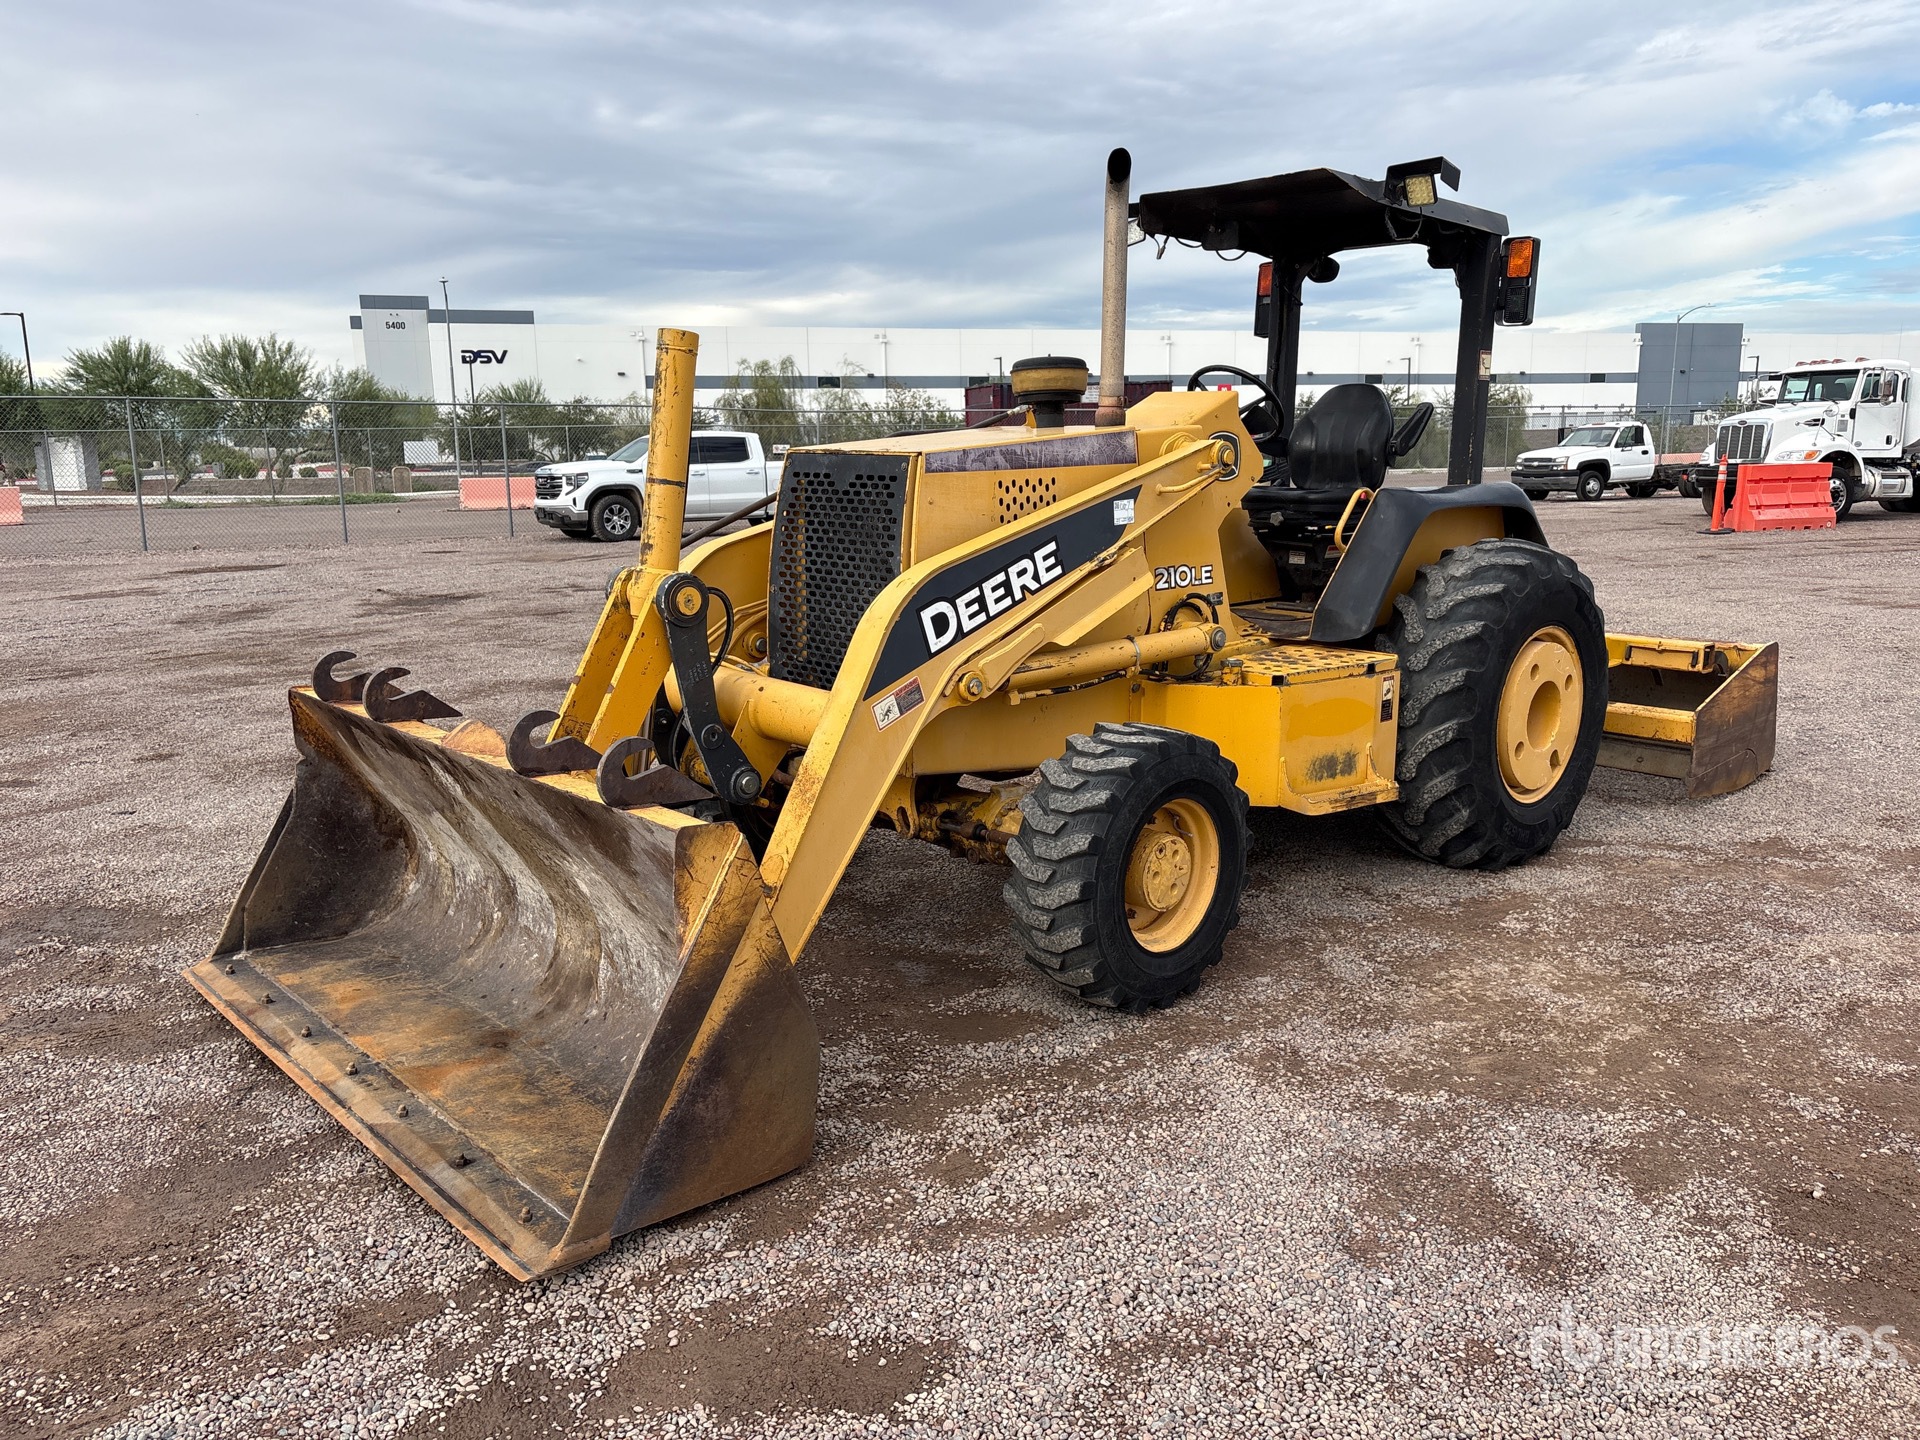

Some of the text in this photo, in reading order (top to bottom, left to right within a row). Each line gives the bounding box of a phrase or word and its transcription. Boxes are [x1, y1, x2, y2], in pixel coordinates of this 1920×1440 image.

[385, 321, 406, 330] 5400
[461, 350, 508, 364] DSV
[1155, 565, 1213, 590] 210LE
[920, 540, 1063, 654] DEERE
